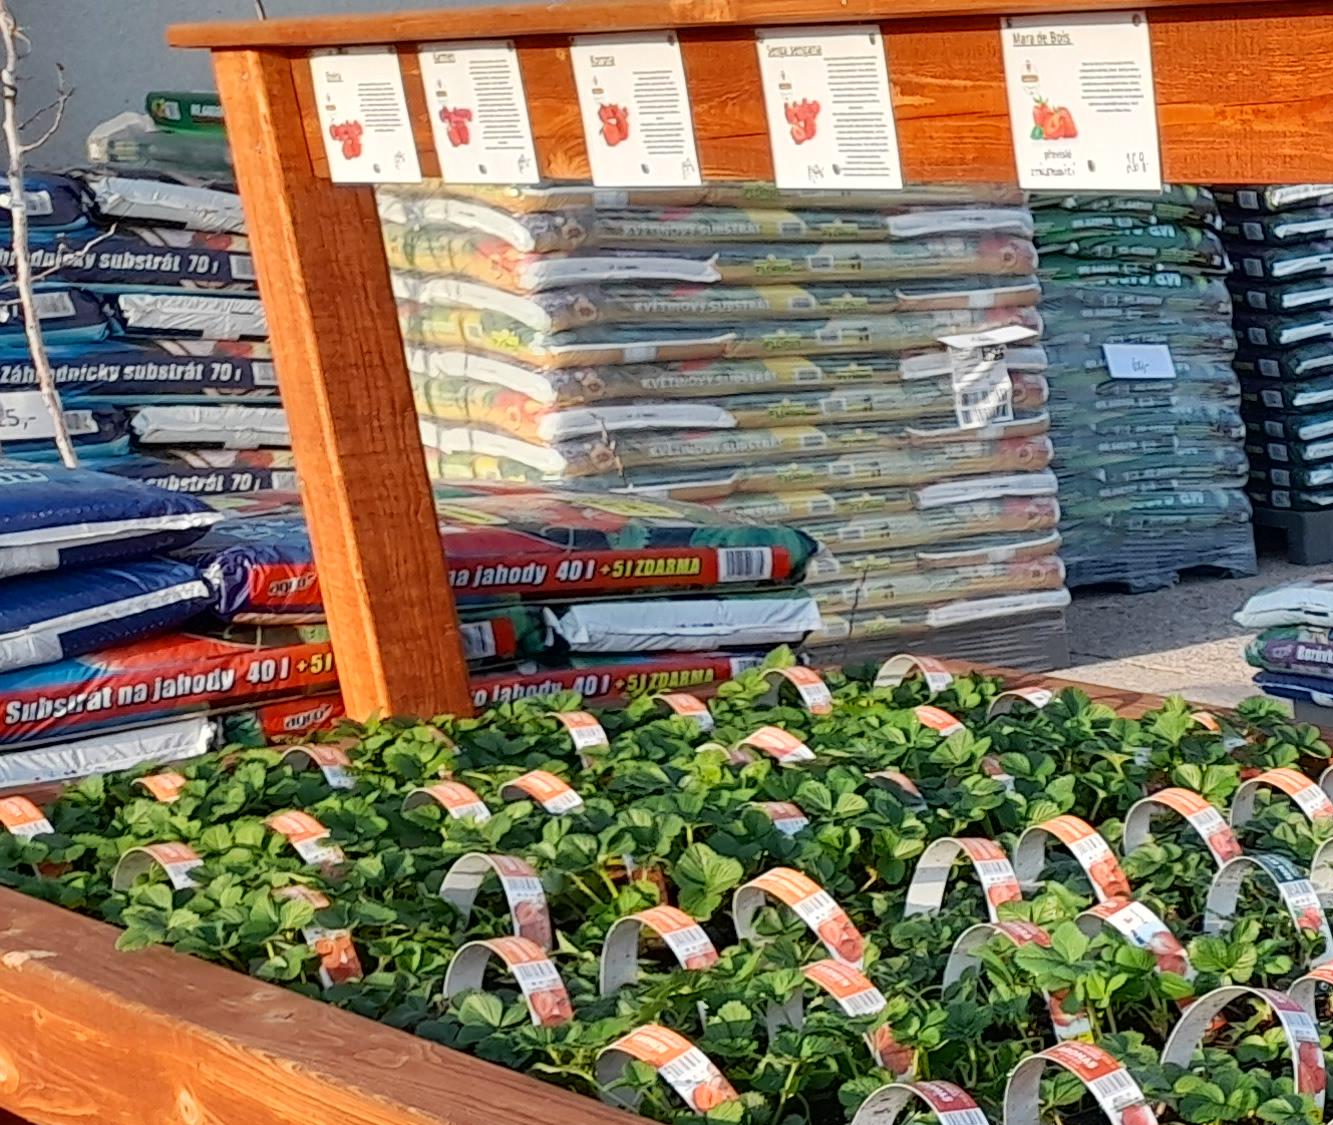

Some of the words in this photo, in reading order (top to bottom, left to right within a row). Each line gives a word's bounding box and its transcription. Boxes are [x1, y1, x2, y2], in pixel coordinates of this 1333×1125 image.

[99, 250, 181, 272] substrát
[188, 253, 211, 274] 70
[0, 363, 120, 384] Záhdnícky
[123, 362, 203, 382] substrát
[211, 363, 235, 382] 70
[0, 408, 37, 429] 5,-
[231, 473, 252, 491] 70
[473, 562, 547, 589] jahody
[555, 560, 584, 582] 40
[634, 557, 701, 577] ZDARMA
[4, 686, 112, 726] Substrát
[118, 684, 148, 705] na
[150, 665, 236, 705] jahody
[246, 658, 274, 685] 40
[572, 675, 602, 697] 40
[648, 667, 714, 690] ZDARMA
